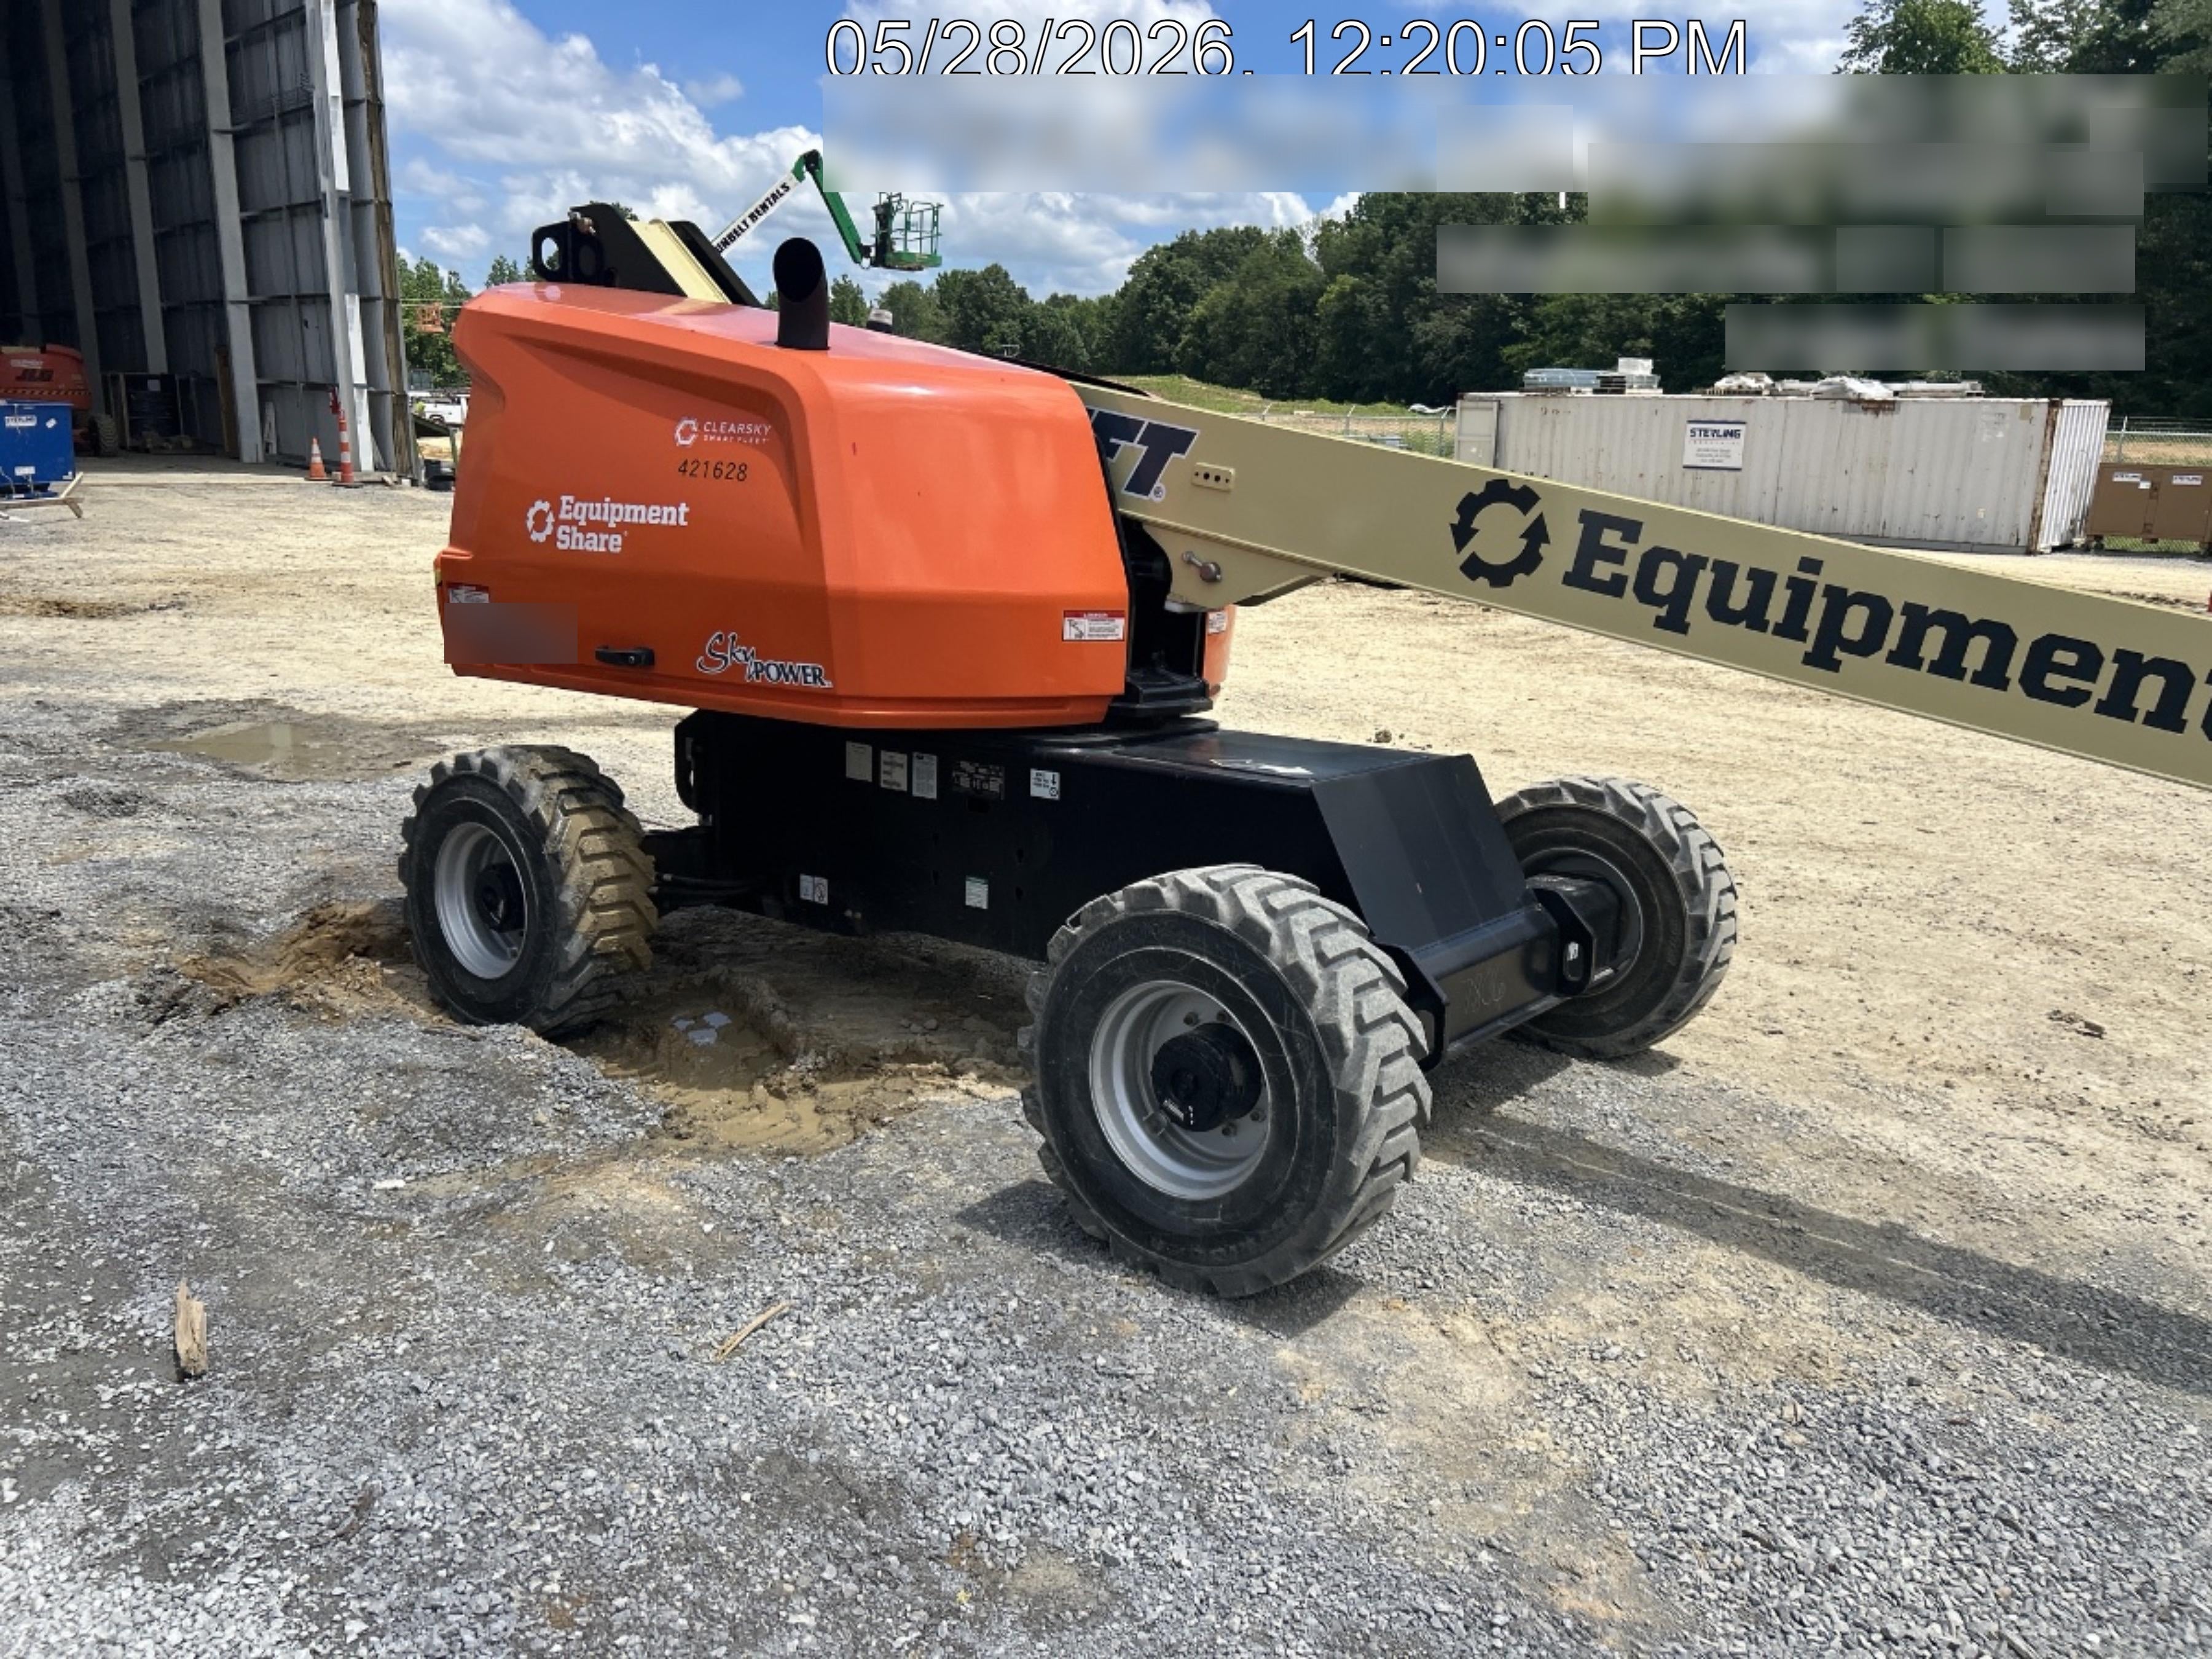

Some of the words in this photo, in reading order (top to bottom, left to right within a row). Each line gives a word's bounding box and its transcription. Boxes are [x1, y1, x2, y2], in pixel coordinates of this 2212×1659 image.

[748, 182, 791, 223] RENTALS
[704, 422, 771, 436] CLEARSKY
[678, 459, 748, 482] 421628
[559, 495, 689, 528] Equipment
[556, 525, 622, 553] Share
[697, 631, 756, 683] Sky
[753, 659, 826, 688] POWER
